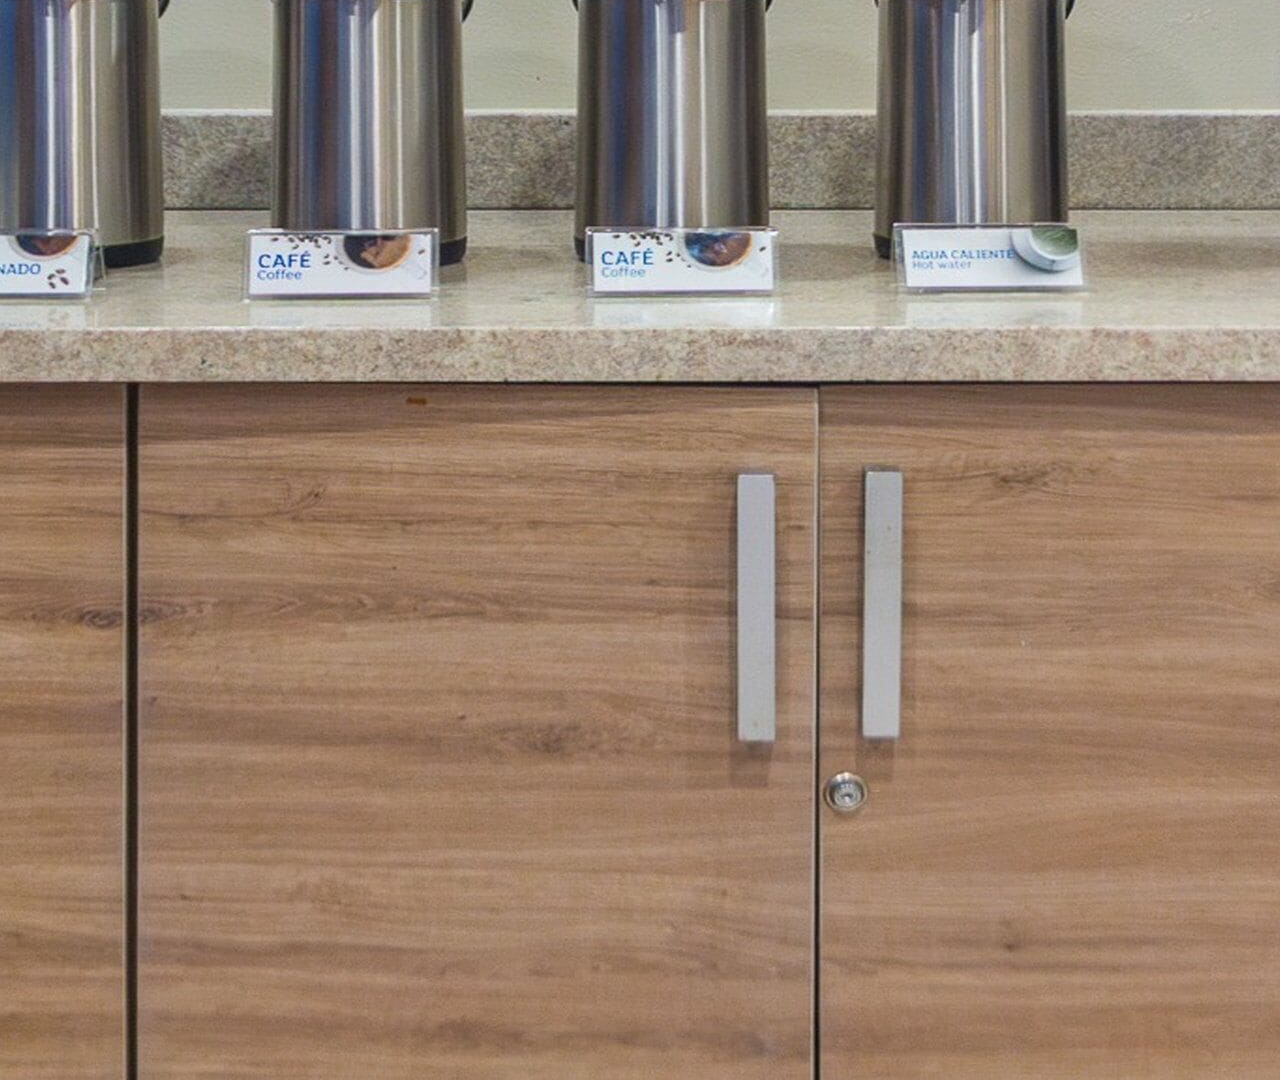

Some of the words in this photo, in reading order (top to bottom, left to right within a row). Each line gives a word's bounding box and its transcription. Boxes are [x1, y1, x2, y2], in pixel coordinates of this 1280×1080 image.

[258, 250, 311, 268] CAFÉ
[601, 248, 654, 265] CAFÉ
[912, 249, 949, 260] AGUA
[951, 248, 1015, 260] CALIENTE
[912, 261, 934, 269] Hot
[938, 261, 972, 269] water
[257, 268, 302, 280] Coffee
[601, 266, 646, 277] Coffee
